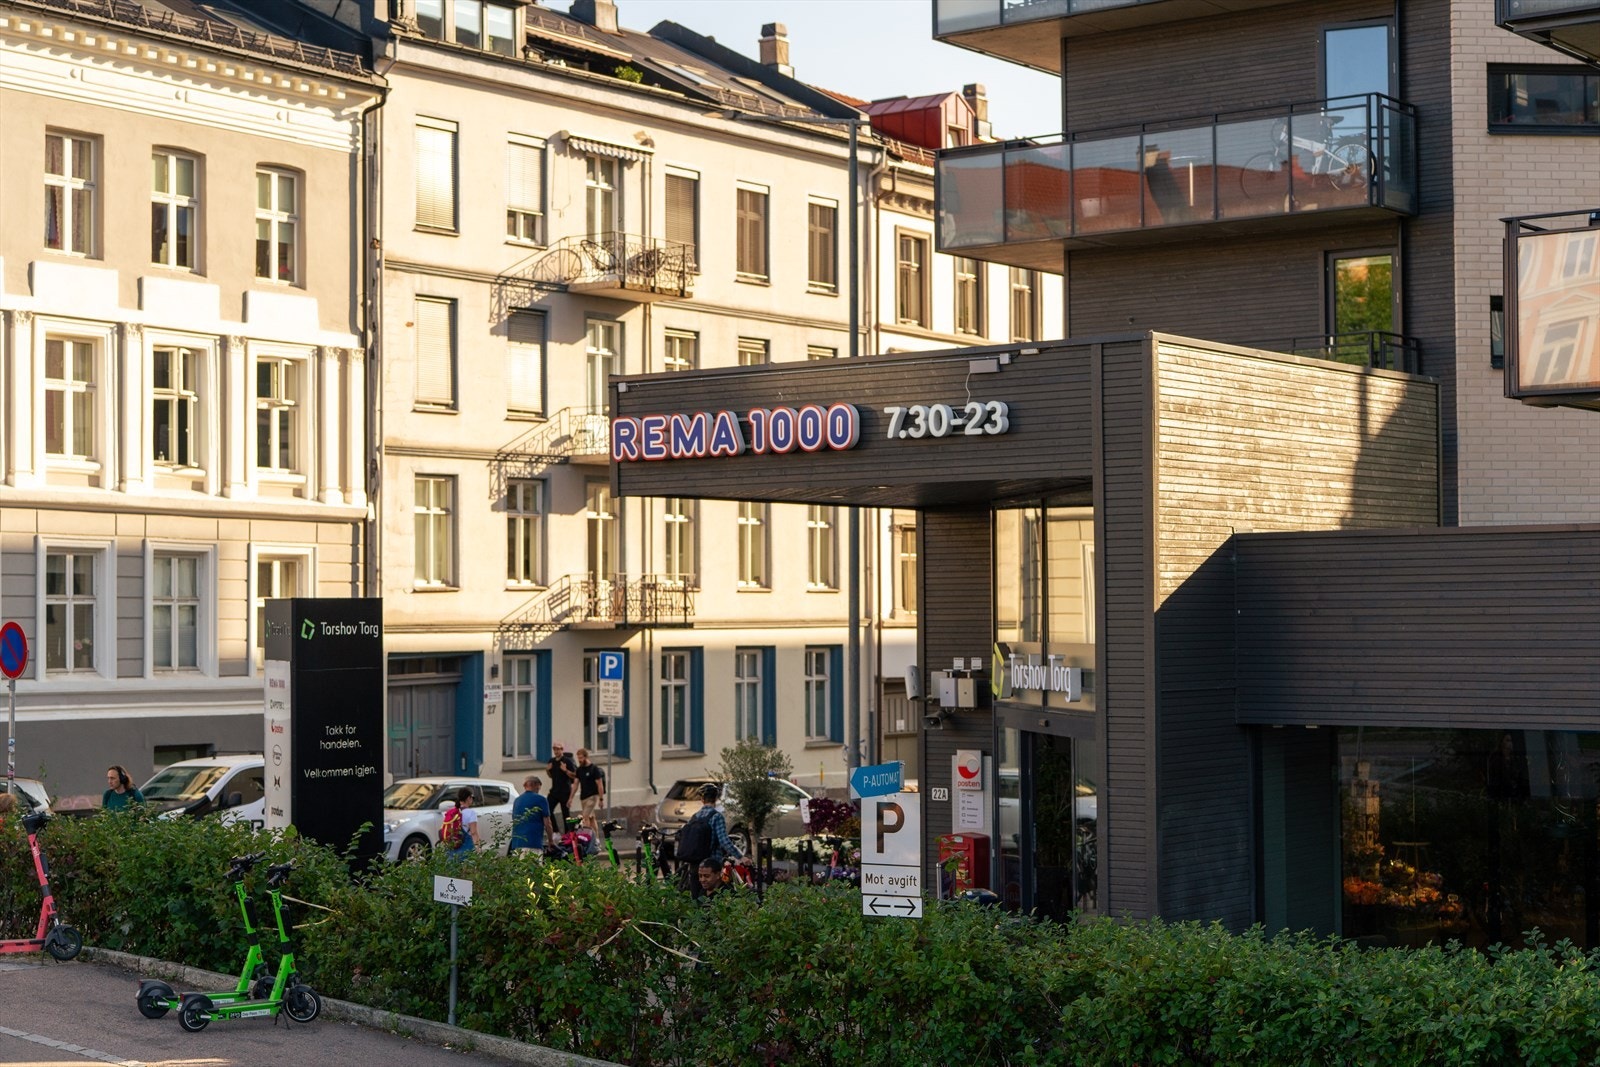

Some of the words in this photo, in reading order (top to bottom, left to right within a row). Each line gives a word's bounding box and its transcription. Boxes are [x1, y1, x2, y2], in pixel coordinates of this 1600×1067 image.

[883, 401, 1004, 439] 7.30-23
[612, 410, 740, 461] REMA
[748, 402, 857, 454] 1000
[320, 621, 358, 635] Torshov
[359, 621, 379, 638] Torg
[604, 655, 618, 677] P
[1008, 653, 1047, 690] Torshov
[1048, 654, 1072, 703] Torg
[487, 704, 497, 715] 27
[325, 725, 344, 736] Takk
[345, 724, 357, 735] for
[319, 738, 362, 750] handelen.
[303, 767, 354, 779] Velkommen
[354, 765, 377, 778] igjen.
[957, 780, 980, 788] posten
[933, 788, 947, 800] 22A
[876, 801, 905, 854] P
[865, 873, 884, 885] Mot
[888, 875, 918, 889] avgift
[440, 891, 449, 900] Mot
[450, 895, 466, 903] avgift
